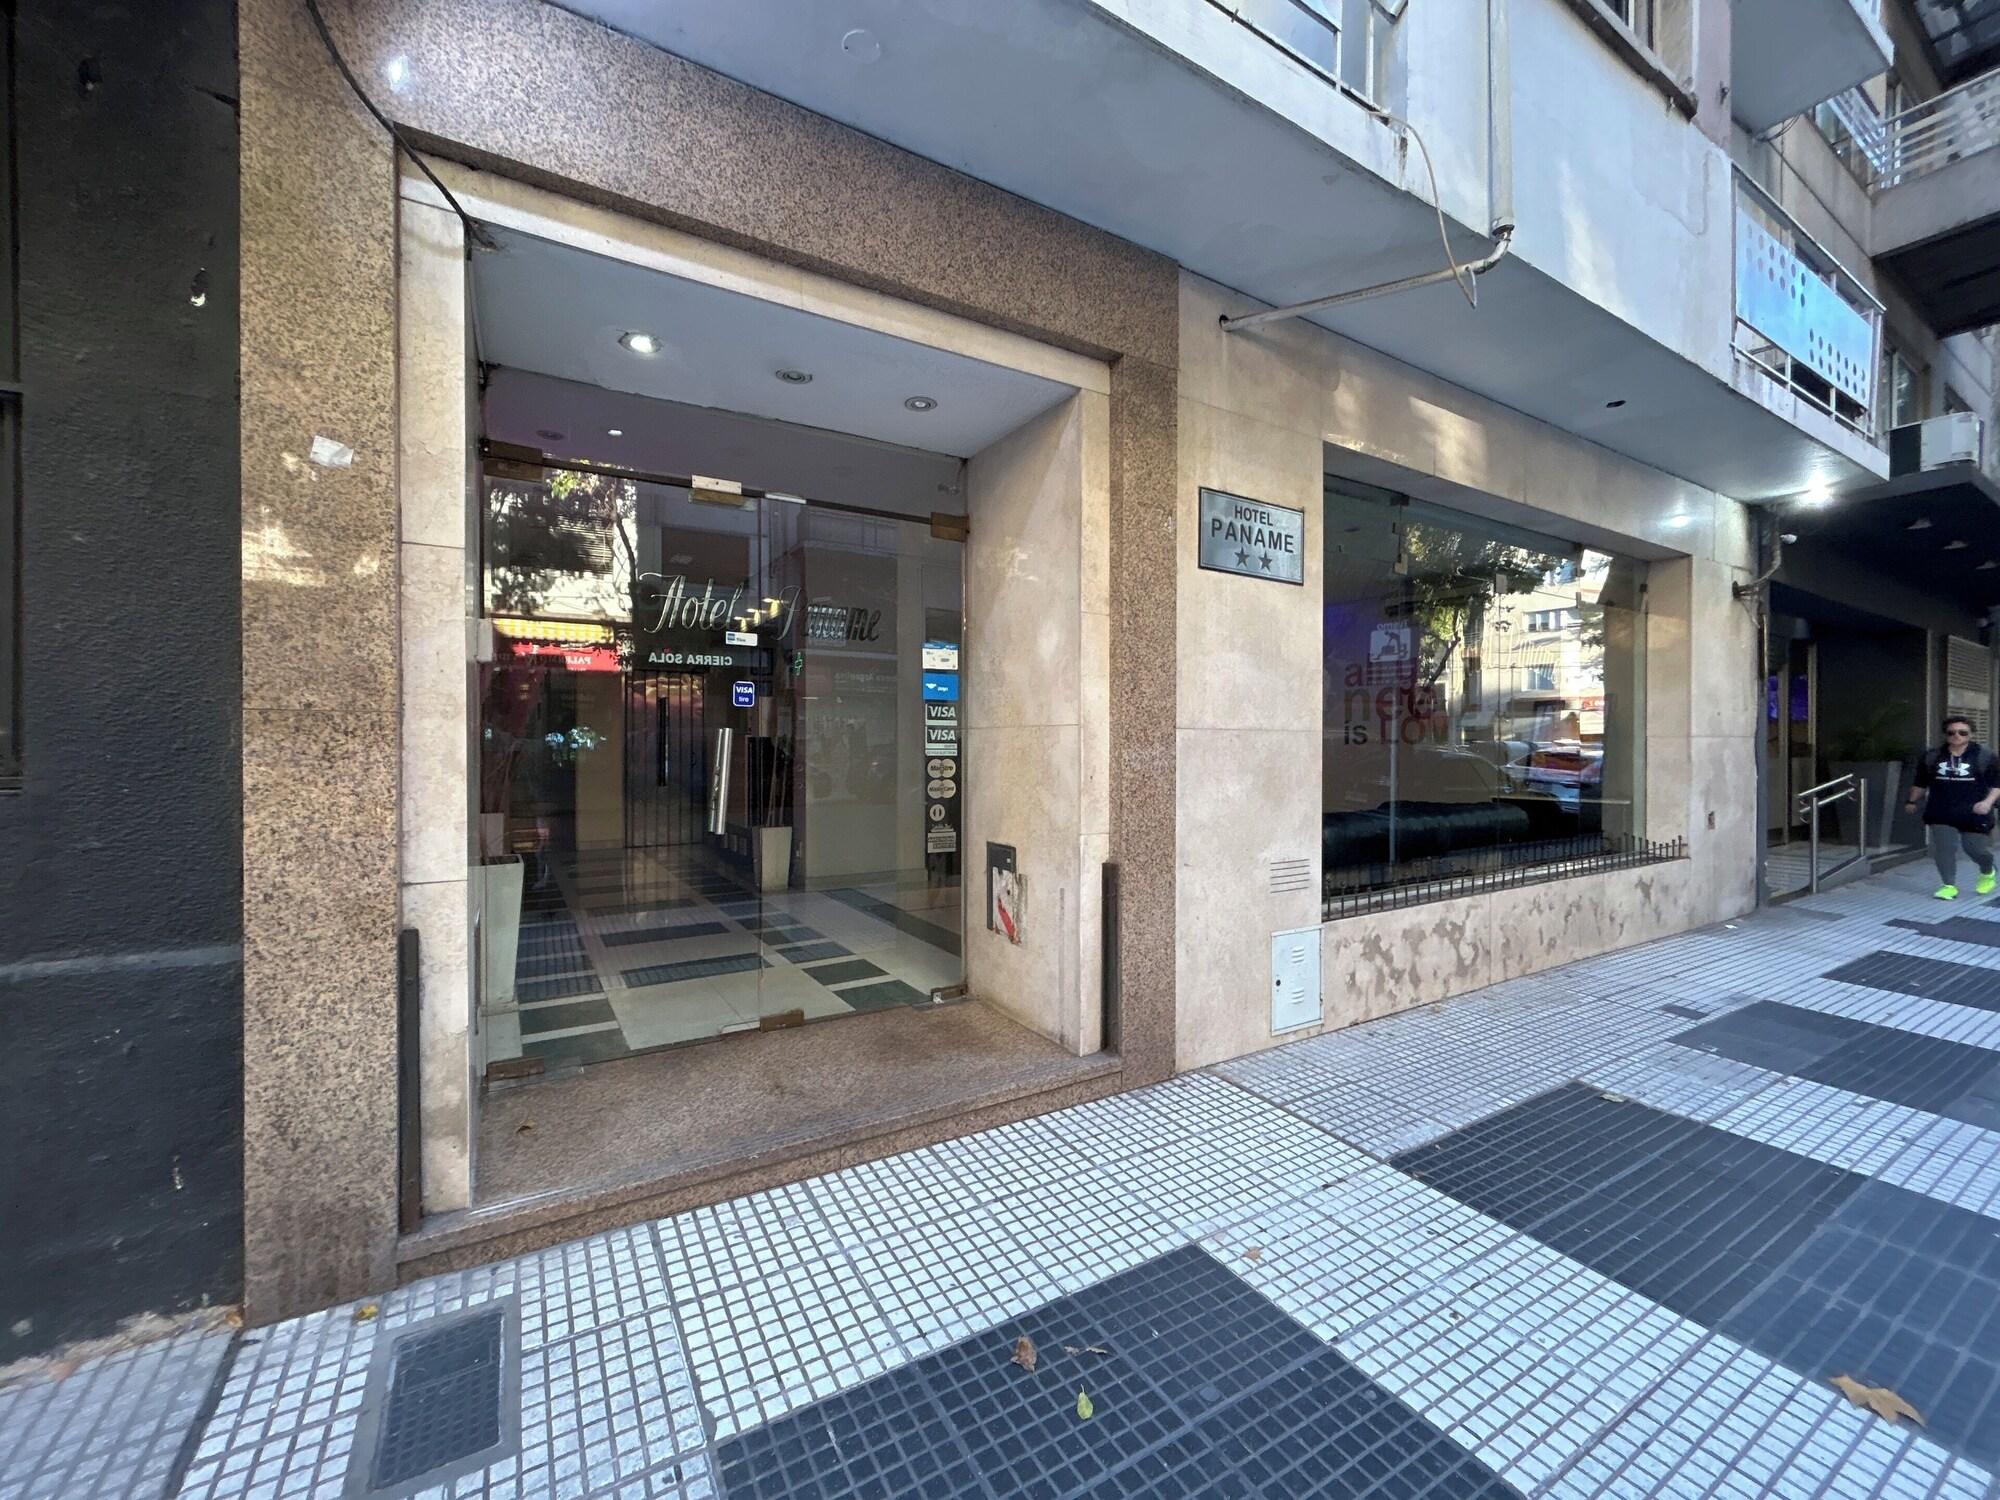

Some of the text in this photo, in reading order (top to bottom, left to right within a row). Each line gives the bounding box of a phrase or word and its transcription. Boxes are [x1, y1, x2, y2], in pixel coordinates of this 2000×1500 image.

[1234, 505, 1273, 527] HOTEL
[1211, 518, 1294, 553] PANAME
[639, 572, 882, 643] Hotel Pme
[736, 686, 753, 694] VISA
[928, 705, 956, 718] VISA
[928, 728, 956, 741] VISA
[1344, 720, 1368, 745] is
